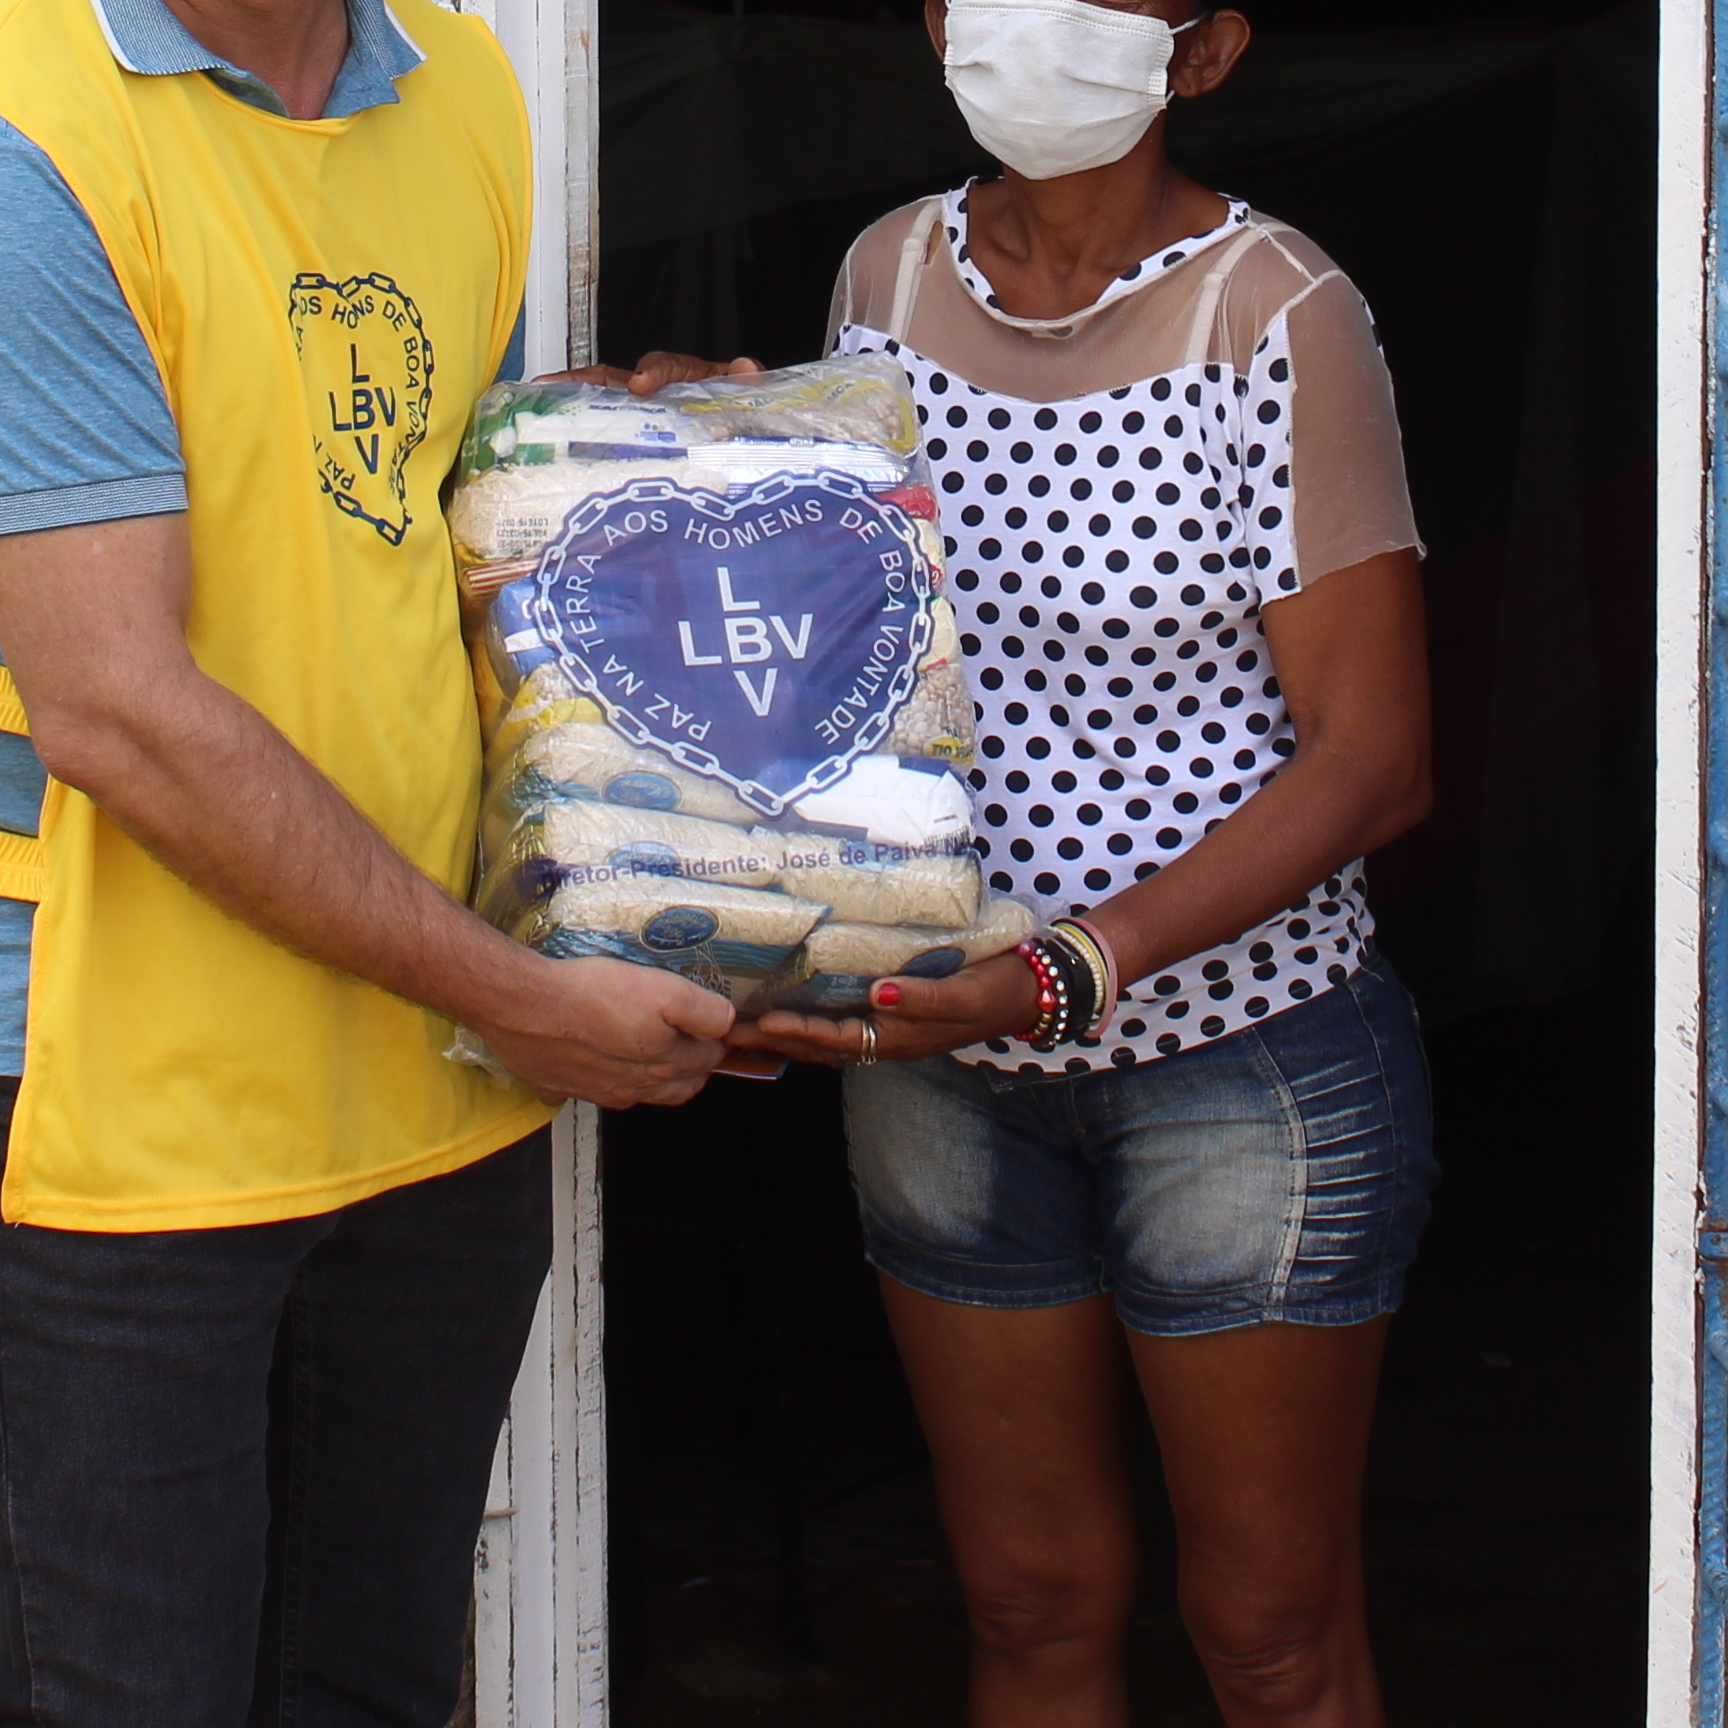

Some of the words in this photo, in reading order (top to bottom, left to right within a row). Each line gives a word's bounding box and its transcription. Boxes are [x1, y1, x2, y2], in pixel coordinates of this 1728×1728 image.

[350, 343, 370, 384] L
[325, 452, 356, 491] PAZ
[382, 300, 407, 332] DE
[403, 336, 420, 389] BOA
[328, 386, 396, 432] LBV
[354, 432, 379, 474] V
[603, 510, 668, 546] AOS
[684, 499, 823, 550] HOMENS
[839, 507, 883, 544] DE
[565, 553, 604, 654] TERRA
[717, 566, 761, 612] L
[879, 550, 906, 612] BOA
[677, 613, 814, 667] LBV
[603, 654, 644, 696] NA
[732, 667, 778, 717] V
[814, 625, 904, 745] VONTADE
[644, 693, 712, 741] PAZ
[777, 847, 831, 870] José
[839, 845, 866, 866] de
[874, 841, 937, 863] Paiva
